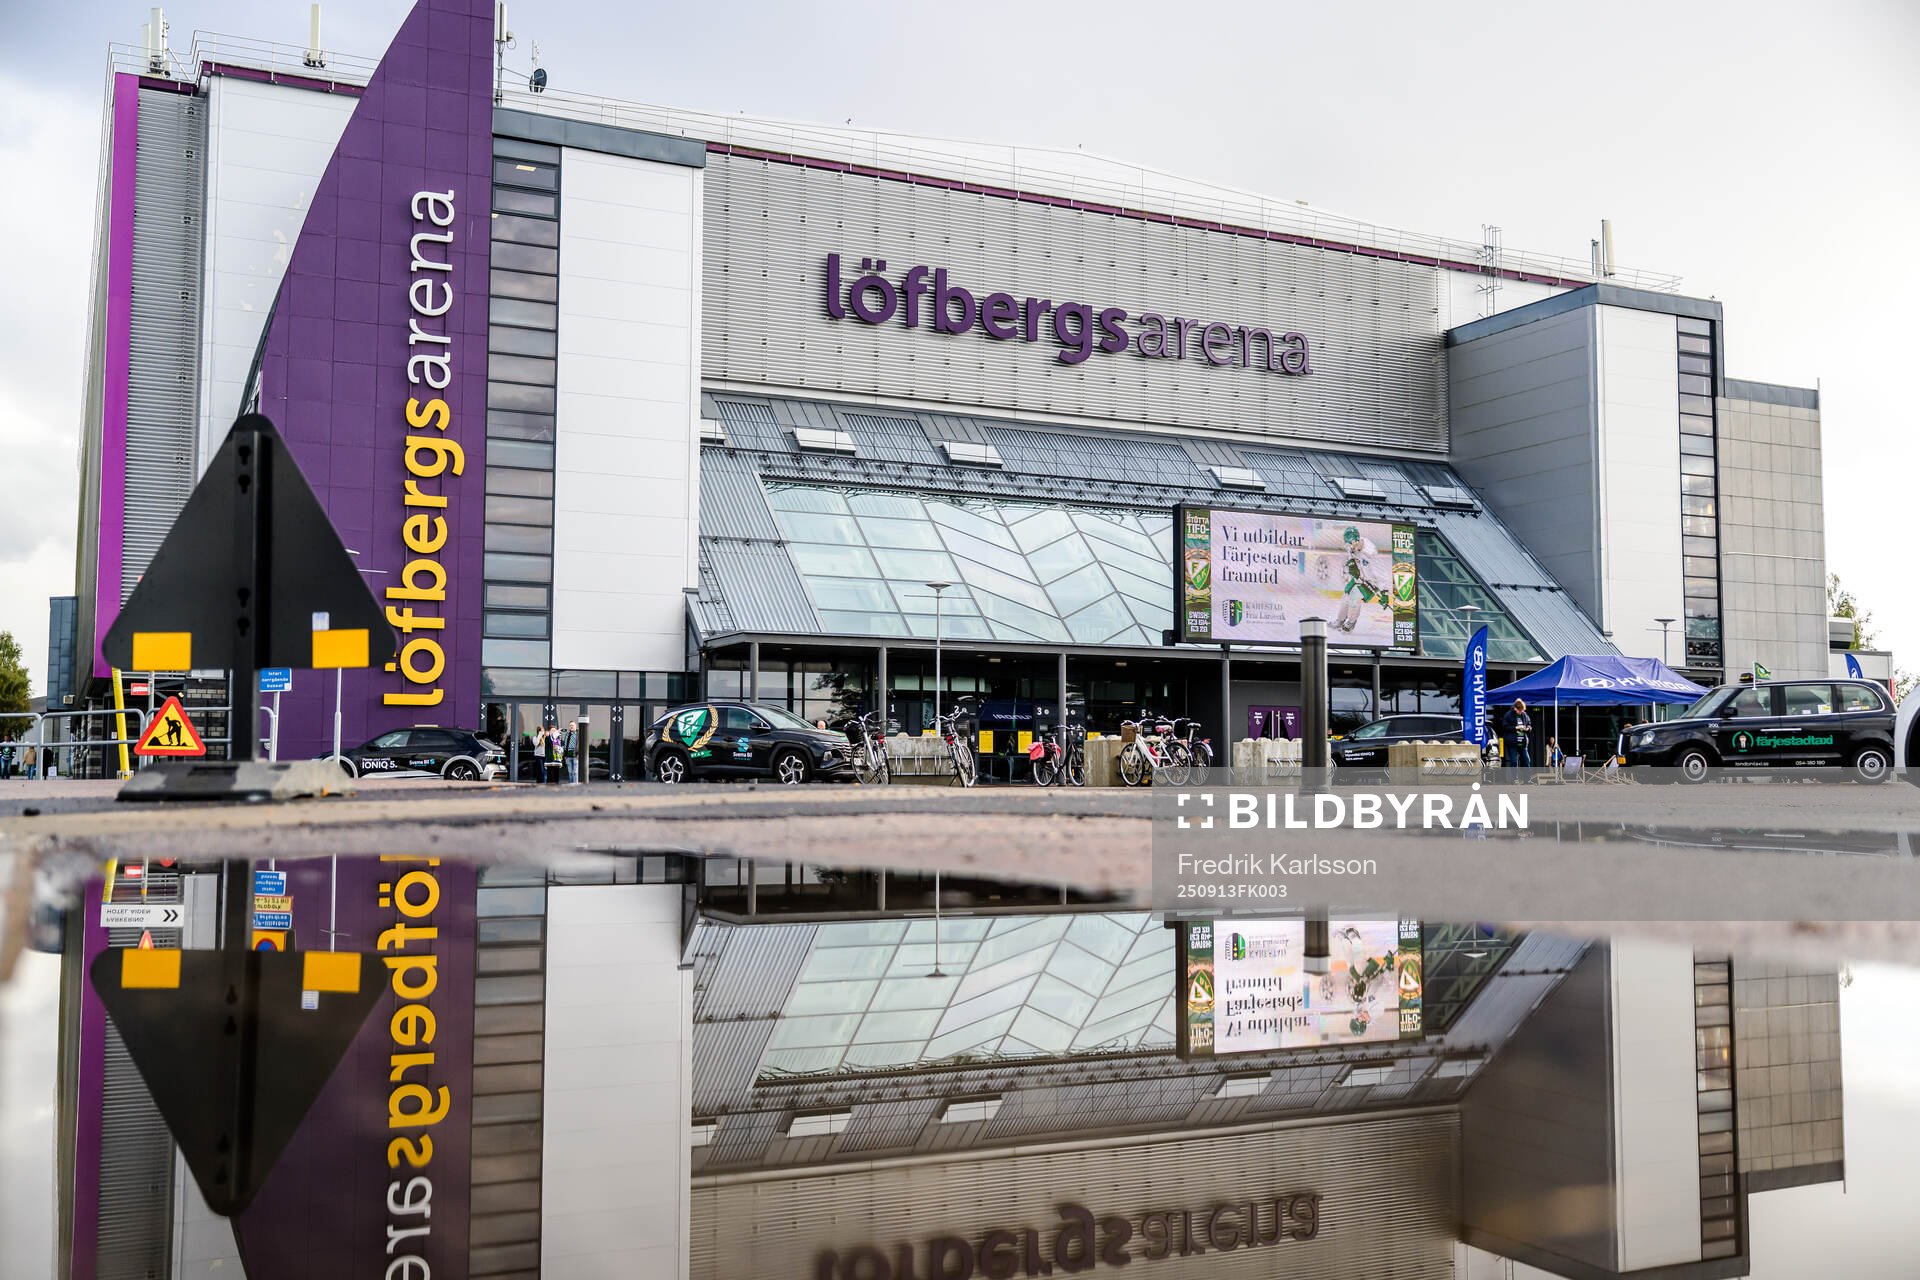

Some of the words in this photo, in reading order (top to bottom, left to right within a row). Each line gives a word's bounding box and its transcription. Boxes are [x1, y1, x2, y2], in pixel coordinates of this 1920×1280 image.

[826, 253, 1313, 375] löfbergsarena
[384, 190, 465, 706] löfbergsarena
[1223, 525, 1238, 542] Vi
[1243, 529, 1304, 546] utbildar
[1223, 546, 1298, 566] Färjestads
[1223, 566, 1278, 584] framtid
[890, 704, 896, 712] 1
[954, 705, 960, 713] 2
[1037, 707, 1042, 715] 3
[1141, 709, 1146, 717] 5
[1473, 674, 1484, 741] HYUNDAI
[1756, 735, 1833, 748] färjestadtaxi
[362, 761, 388, 769] IONIQ
